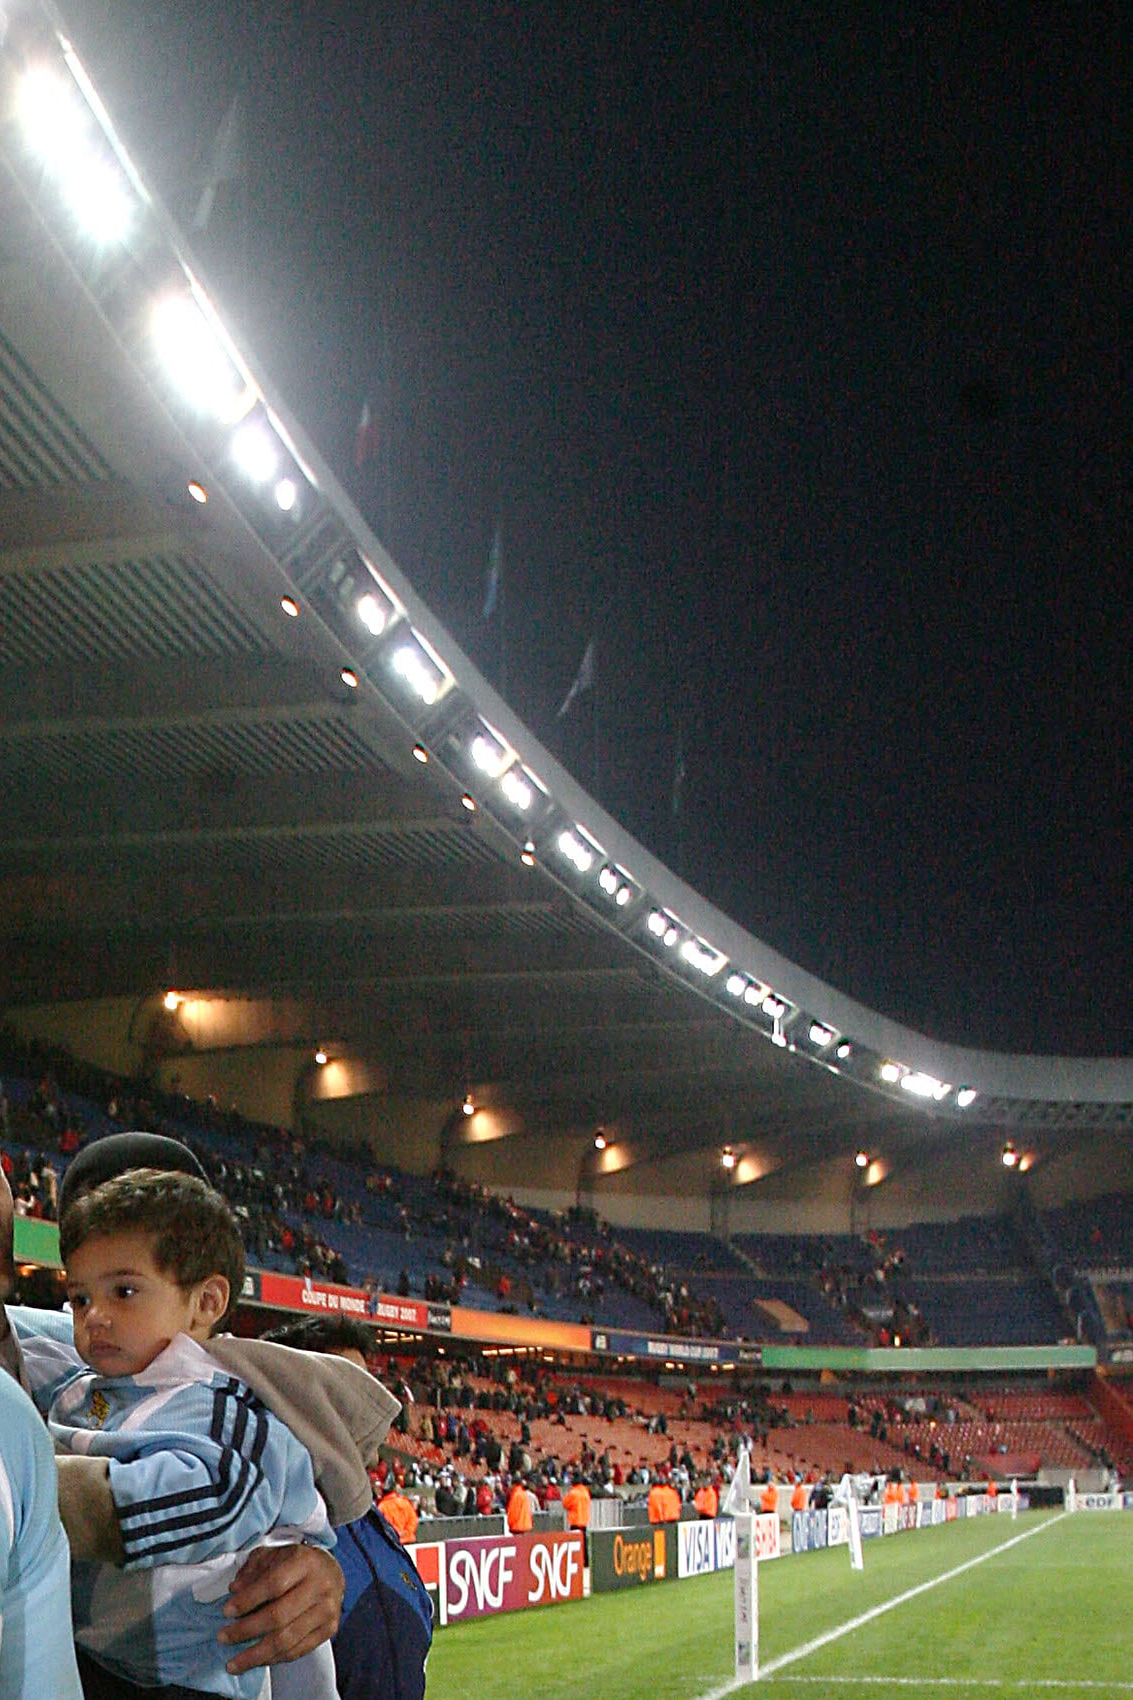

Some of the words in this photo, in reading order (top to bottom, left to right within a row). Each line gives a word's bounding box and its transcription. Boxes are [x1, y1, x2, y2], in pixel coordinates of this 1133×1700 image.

[302, 1289, 327, 1306] COUPE
[328, 1293, 339, 1309] DU
[528, 1540, 582, 1603] SNCF
[614, 1533, 653, 1582] Orange
[683, 1525, 710, 1573] VISA
[447, 1546, 517, 1616] SNCF
